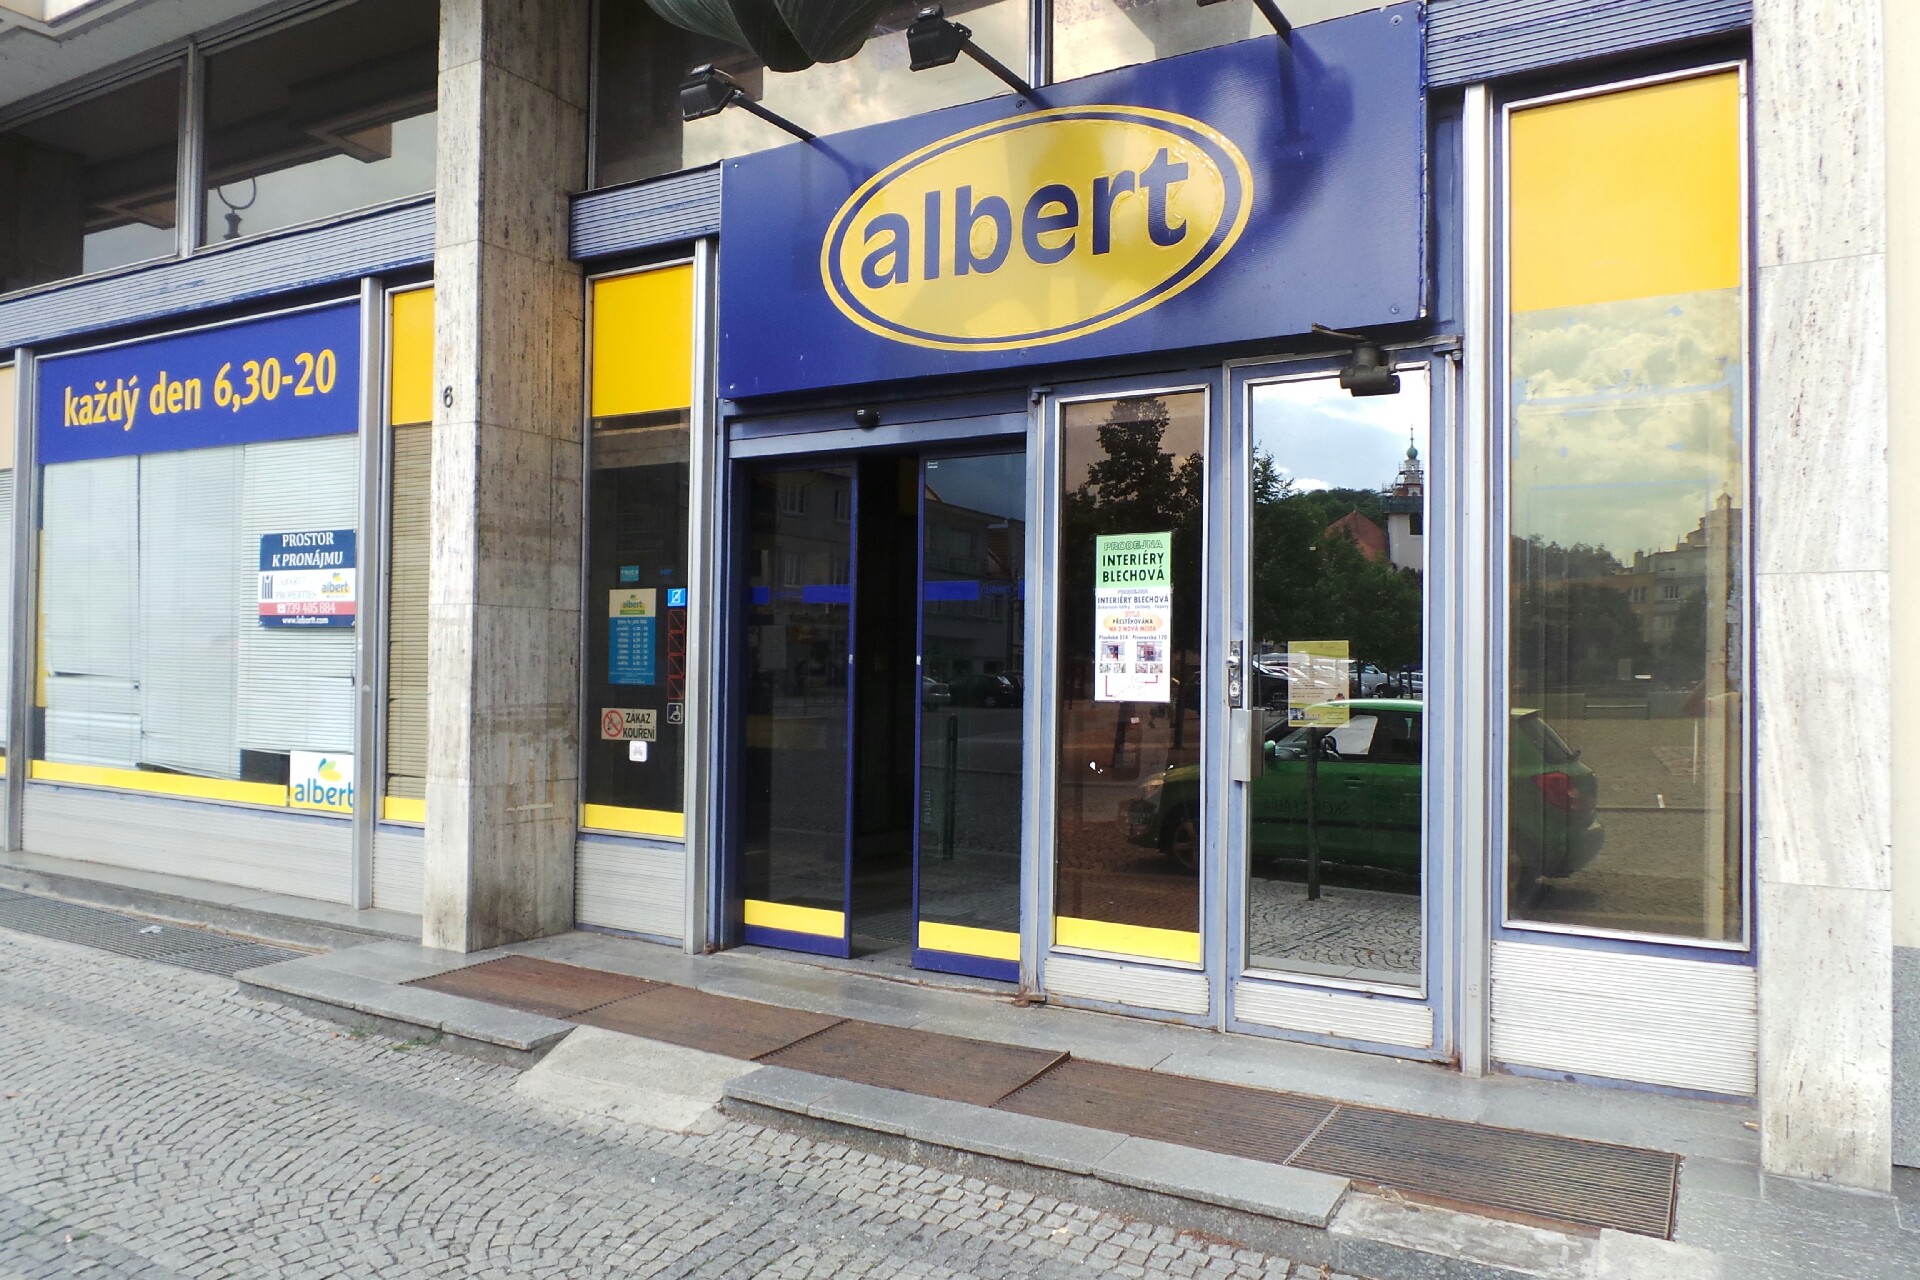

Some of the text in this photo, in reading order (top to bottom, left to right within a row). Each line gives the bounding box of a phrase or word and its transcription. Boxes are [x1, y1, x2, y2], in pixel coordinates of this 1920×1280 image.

[860, 147, 1188, 290] albert
[64, 349, 336, 431] každý den 6,30-20
[443, 385, 454, 409] 6
[282, 532, 334, 547] PROSTOR
[1103, 540, 1163, 551] PRODEJNA
[272, 549, 343, 568] K PRONÁJMU
[1102, 550, 1164, 566] INTERIÉRY
[1102, 565, 1165, 582] BLECHOVÁ
[321, 581, 349, 593] albert
[622, 600, 643, 608] albert
[1097, 594, 1169, 604] INTERIÉRY BLECHOVÁ
[625, 710, 651, 724] ZÁKAZ
[622, 725, 655, 739] KOUŘENÍ
[294, 778, 353, 808] albert
